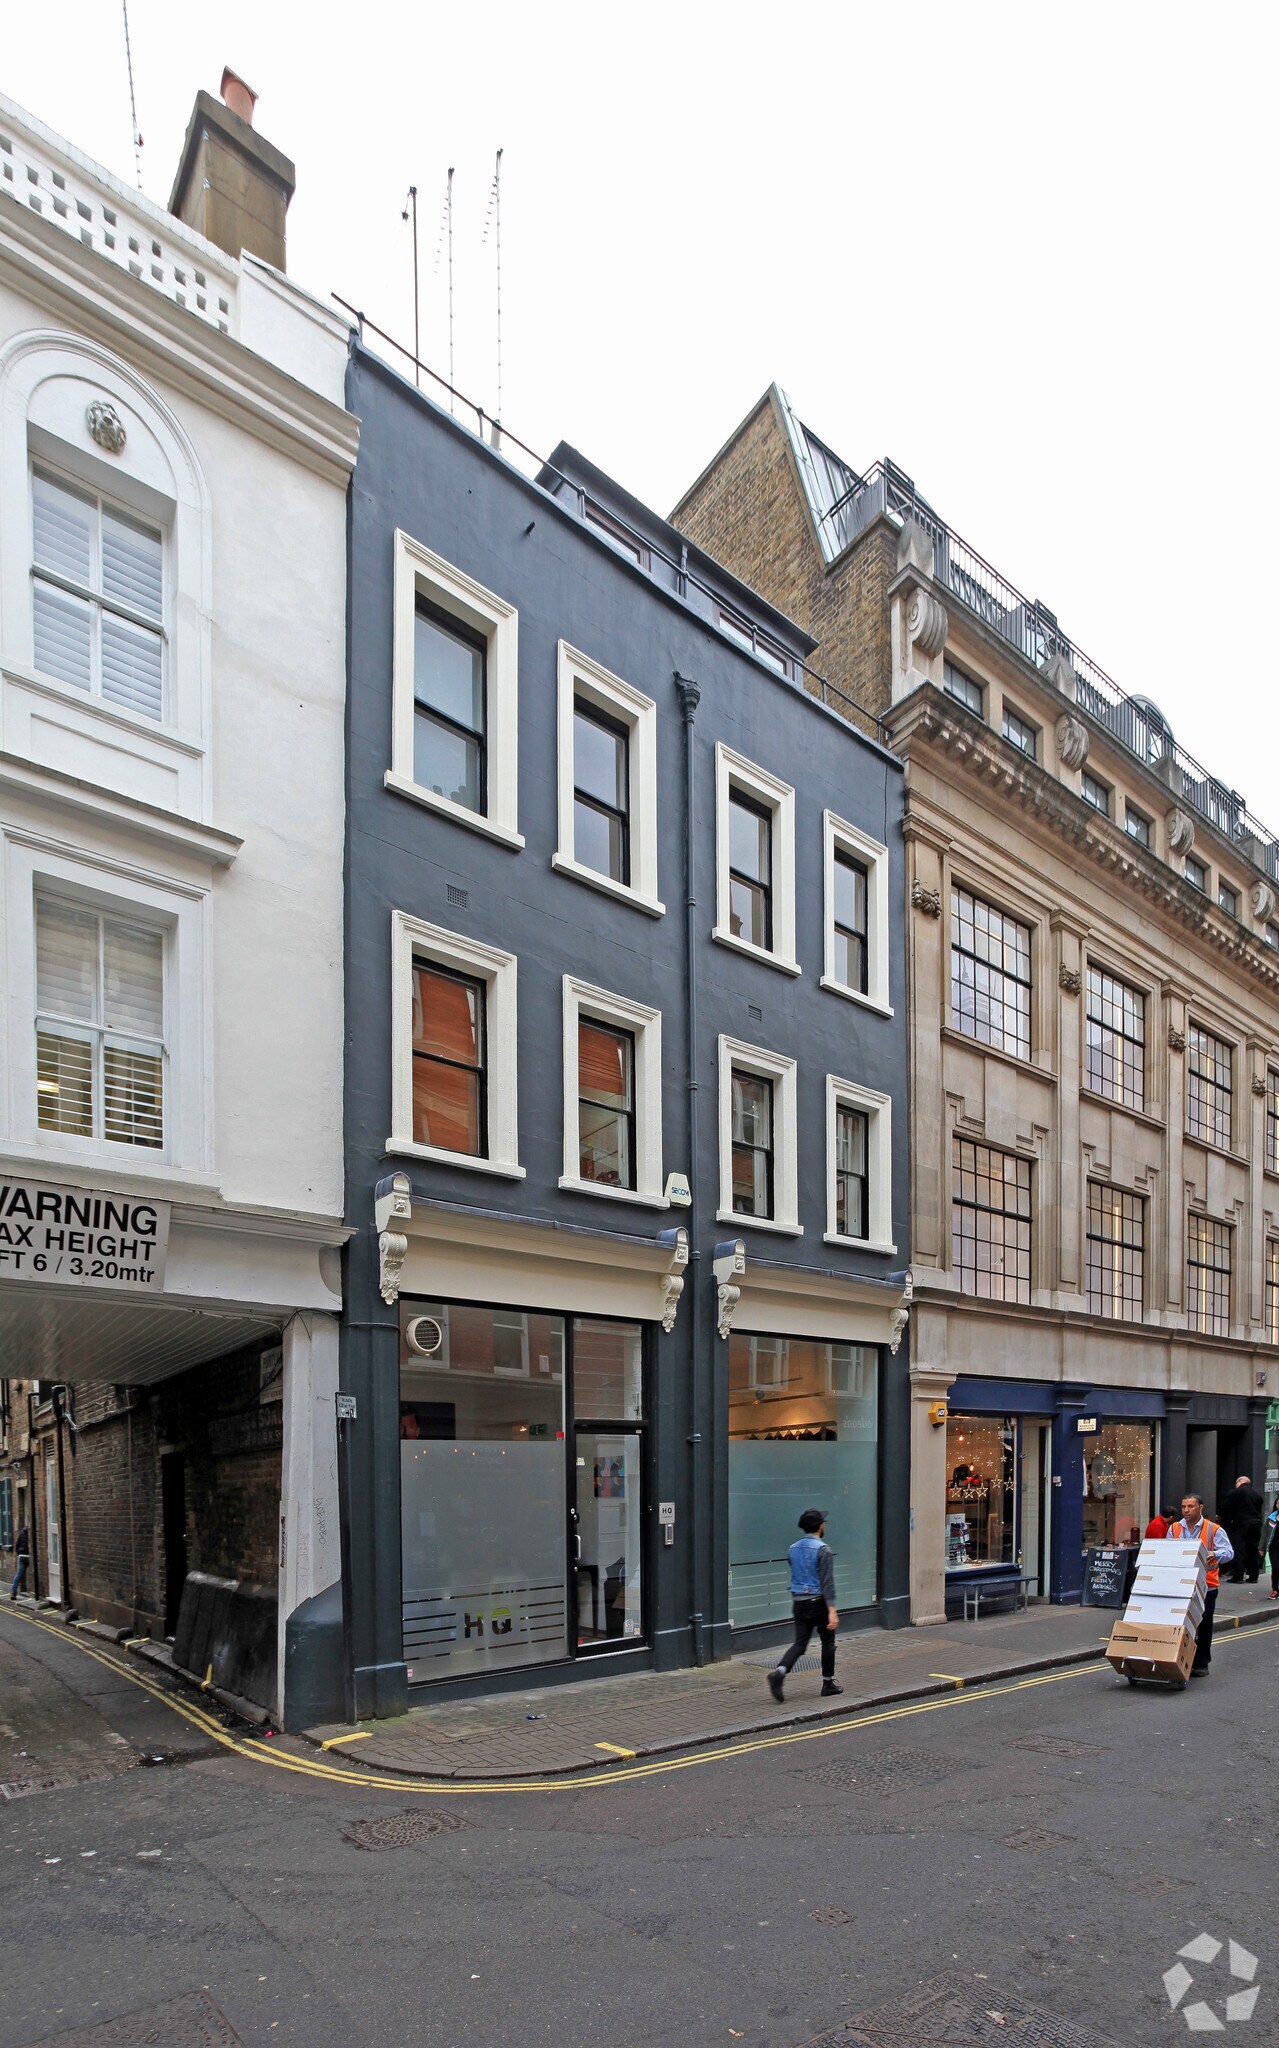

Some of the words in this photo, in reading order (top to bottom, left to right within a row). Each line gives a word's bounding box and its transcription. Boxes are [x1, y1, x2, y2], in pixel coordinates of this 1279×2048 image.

[46, 1228, 156, 1261] HEIGHT
[33, 1253, 47, 1272] 6
[55, 1256, 63, 1274] /
[70, 1257, 155, 1282] 3.20mtr
[1094, 1560, 1116, 1568] MERRY
[1092, 1583, 1117, 1592] ANIMALS
[464, 1606, 512, 1638] HQ
